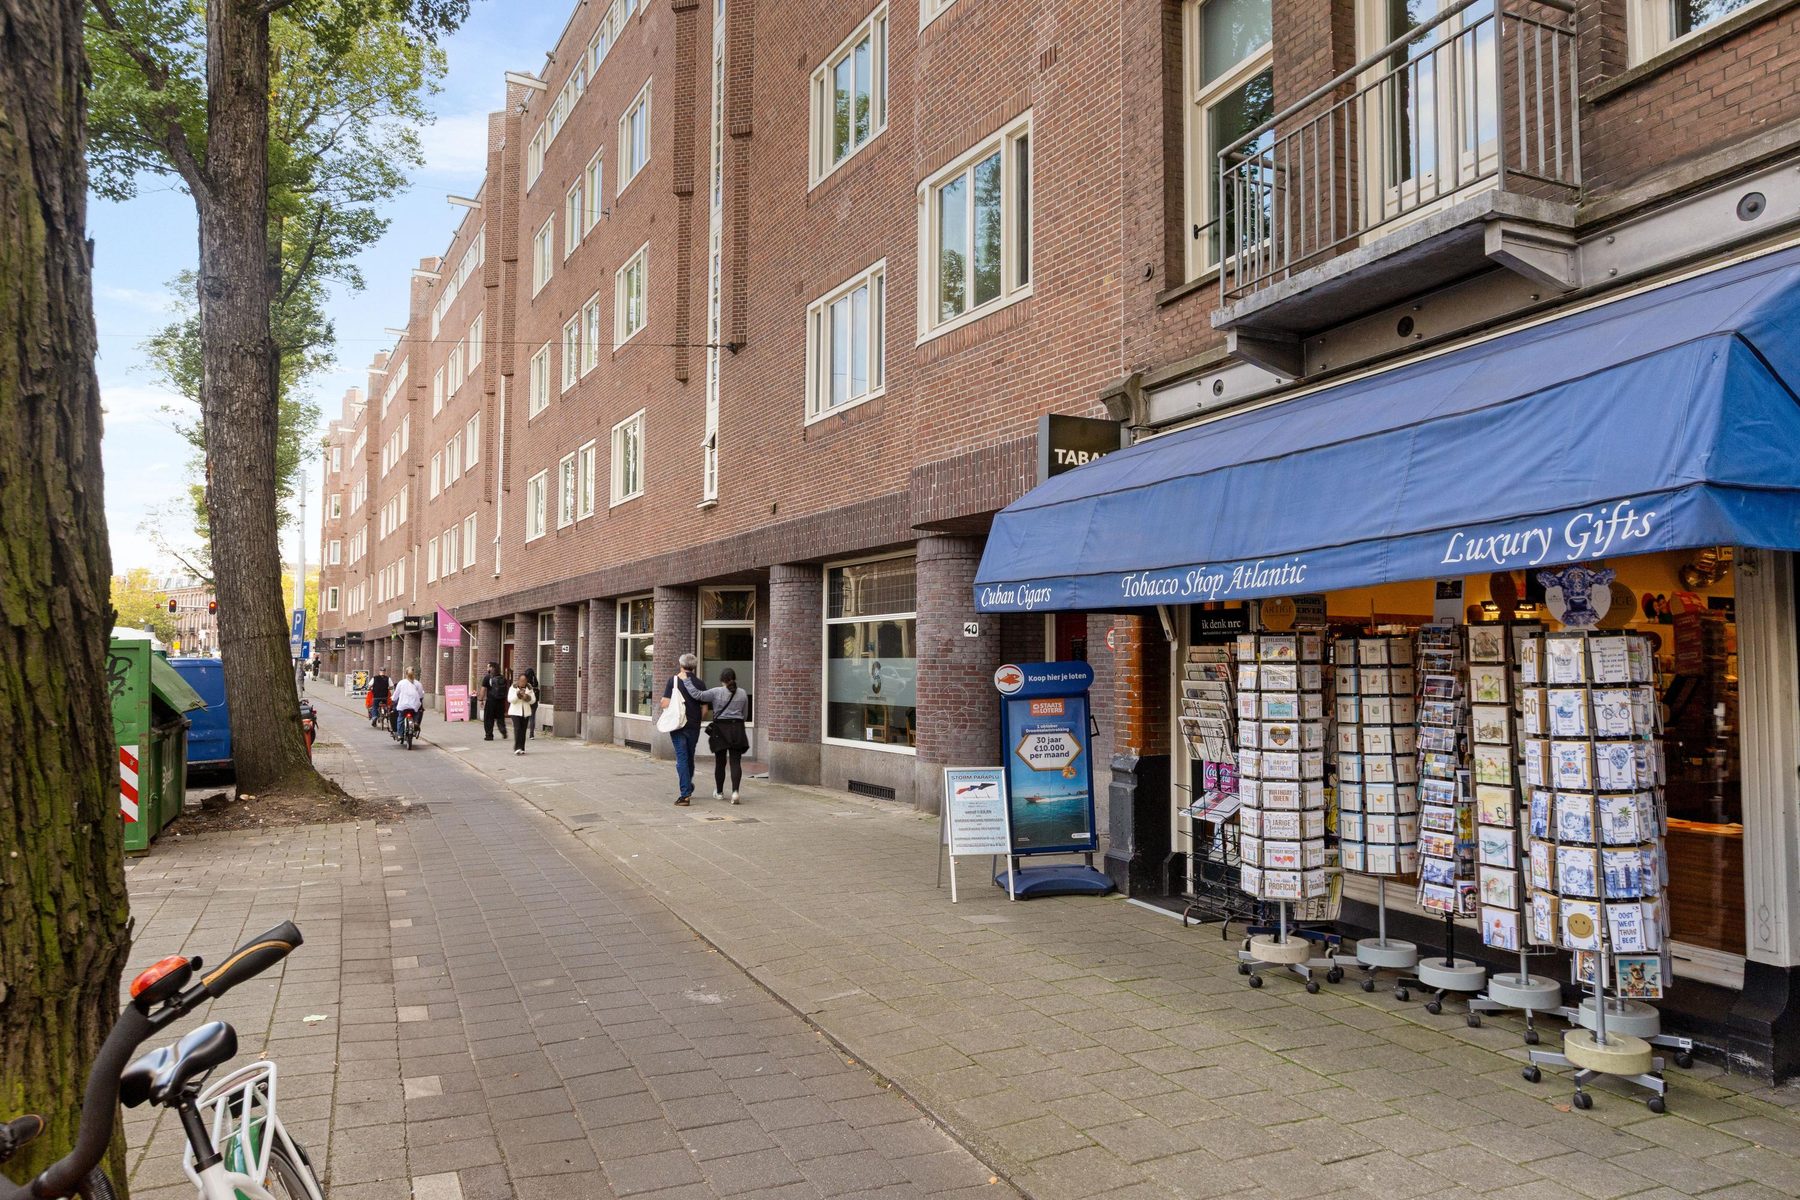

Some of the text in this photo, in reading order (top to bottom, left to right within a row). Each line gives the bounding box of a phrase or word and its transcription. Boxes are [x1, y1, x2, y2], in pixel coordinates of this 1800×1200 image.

[1054, 448, 1106, 466] TABA
[1441, 500, 1656, 566] Luxury Gifts
[1121, 557, 1308, 600] Tobacco Shop Atlantic
[981, 585, 1052, 612] Cuban Cigars
[294, 613, 302, 630] P
[964, 624, 978, 634] 40
[1202, 618, 1241, 630] ik denk nrc
[1523, 646, 1534, 663] 40
[1525, 698, 1536, 715] 50
